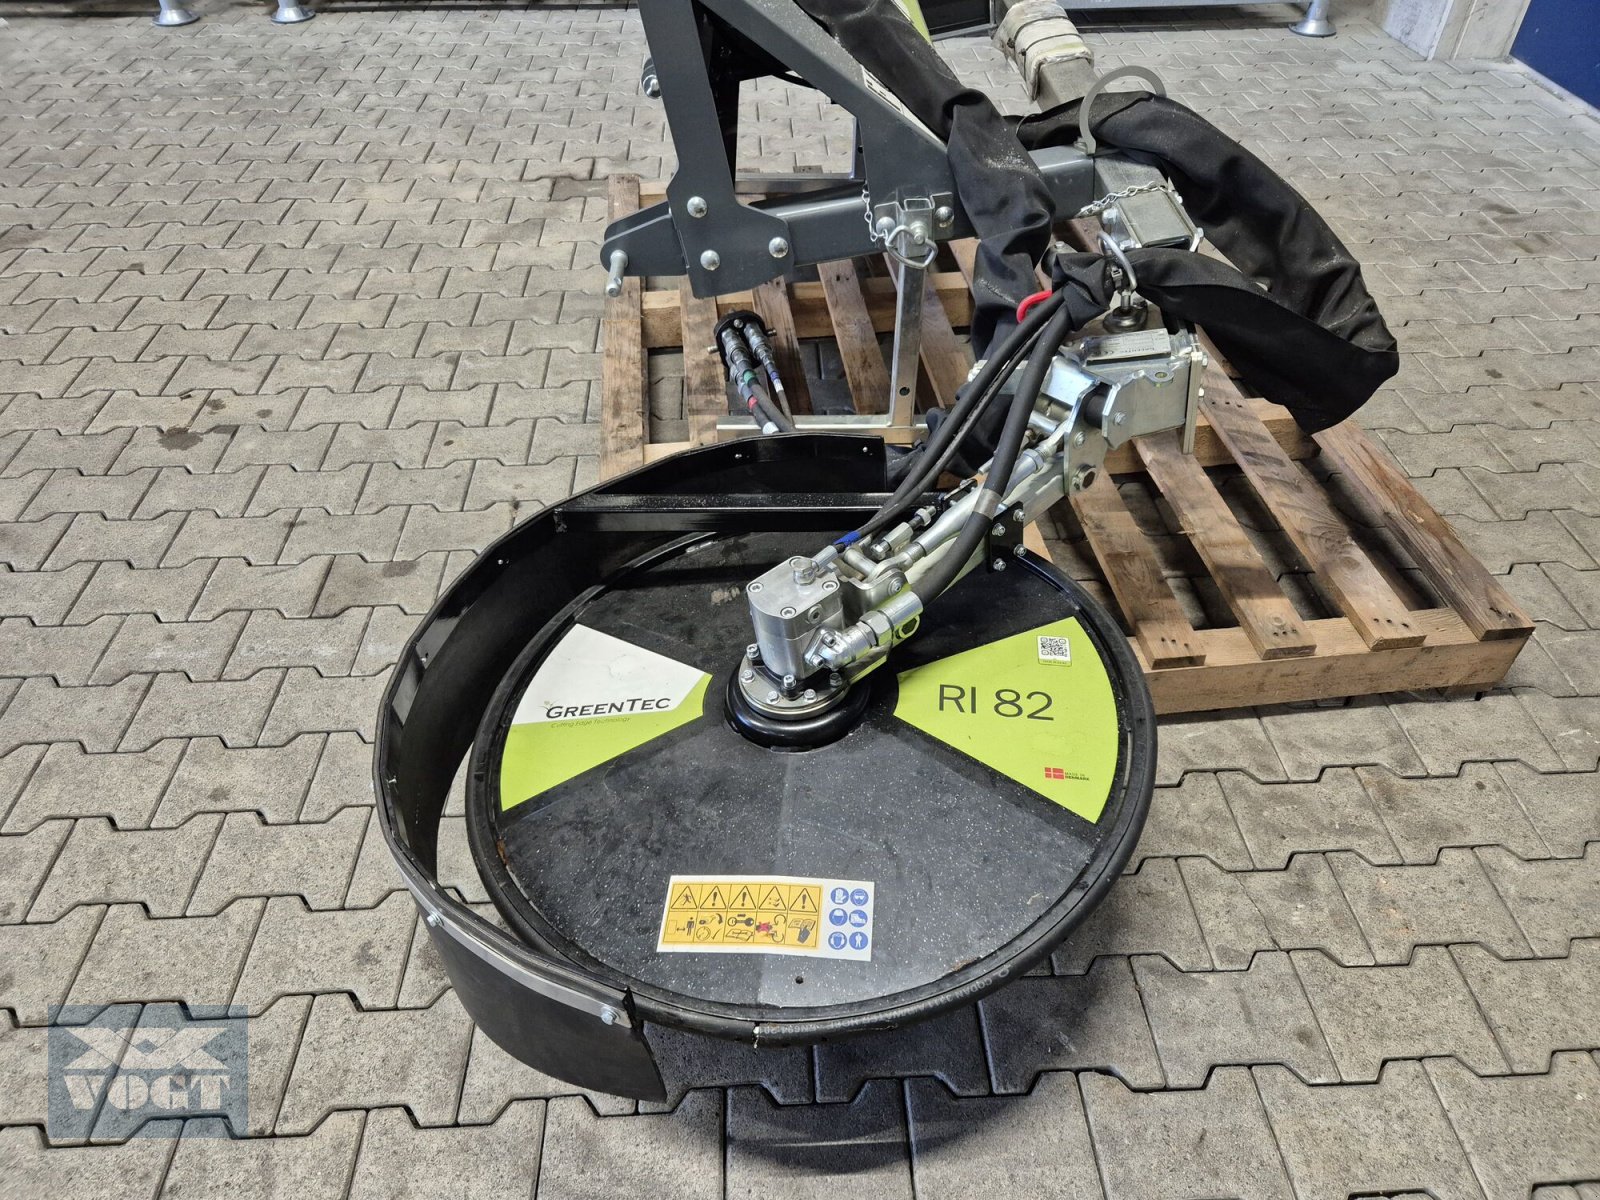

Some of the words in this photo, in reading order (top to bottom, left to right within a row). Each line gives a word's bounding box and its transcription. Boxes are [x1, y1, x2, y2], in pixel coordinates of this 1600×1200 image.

[939, 684, 977, 714] RI
[993, 688, 1054, 721] 82
[955, 977, 993, 999] CODAN
